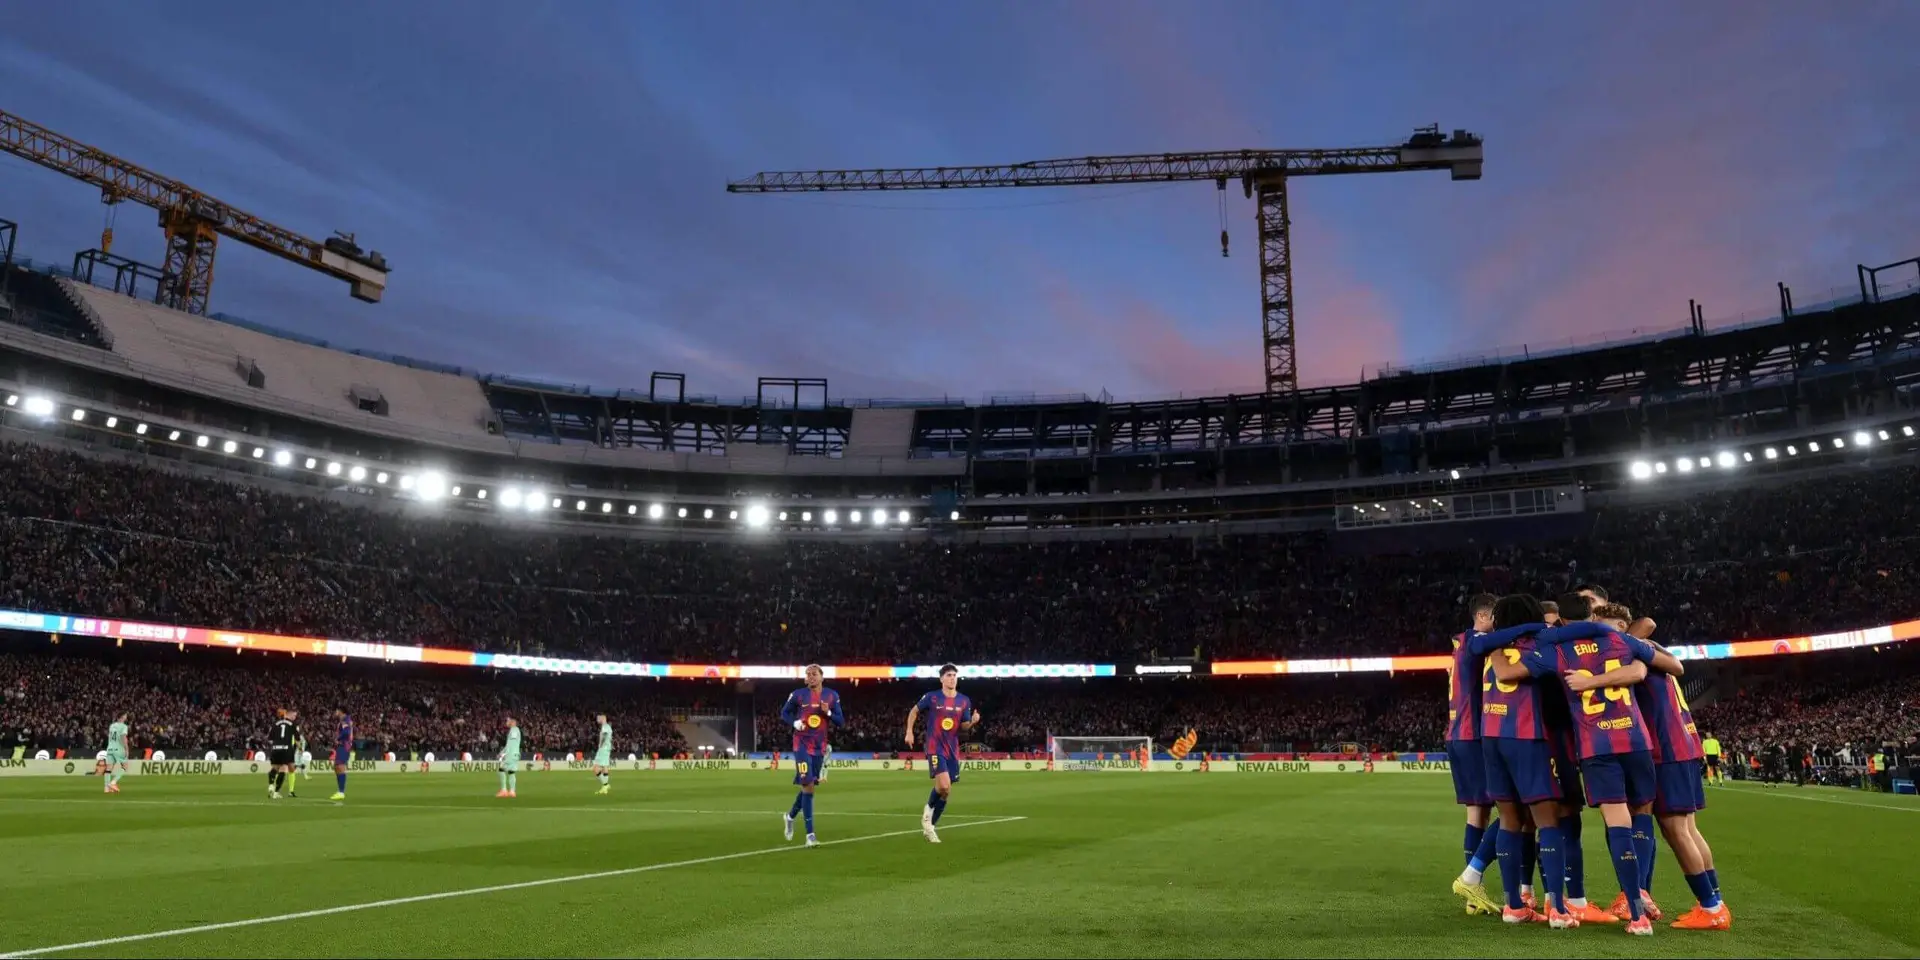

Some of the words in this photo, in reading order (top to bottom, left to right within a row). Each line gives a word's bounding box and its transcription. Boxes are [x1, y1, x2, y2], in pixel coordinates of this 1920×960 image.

[1573, 643, 1599, 656] ERIC
[1577, 659, 1632, 715] 24
[828, 760, 859, 768] LBUM
[931, 755, 938, 765] 5
[1107, 760, 1140, 768] ALBU
[141, 762, 174, 774] NEW
[175, 762, 222, 774] ALBUM
[346, 761, 377, 771] LBUM
[451, 762, 473, 772] NEW
[474, 762, 500, 772] ALBU
[673, 761, 693, 770] NEW
[694, 761, 730, 770] ALBUM
[798, 761, 808, 774] 10
[963, 761, 1001, 771] ALBUM
[1236, 762, 1265, 772] NEW
[1266, 762, 1310, 772] ALBUM
[1401, 762, 1431, 770] NEW
